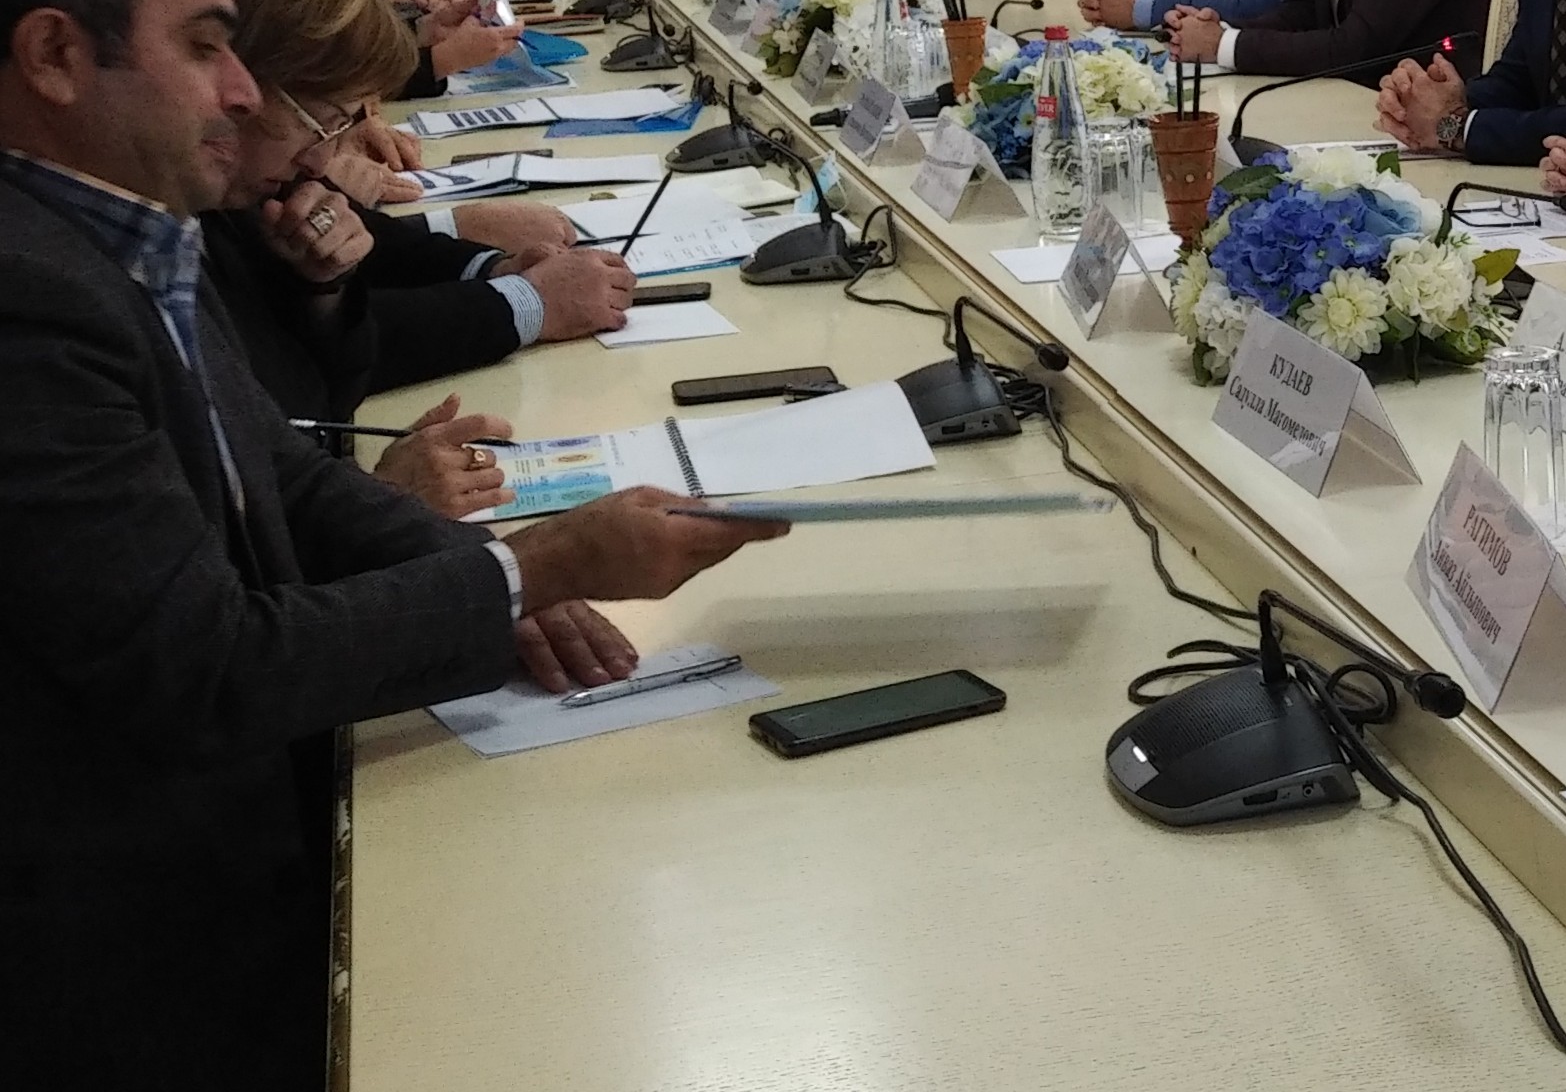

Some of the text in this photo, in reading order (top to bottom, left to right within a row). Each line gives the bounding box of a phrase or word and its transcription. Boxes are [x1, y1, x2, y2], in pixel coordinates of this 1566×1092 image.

[1269, 353, 1313, 396] КУДАЕВ
[1263, 397, 1327, 457] Магомедович
[1463, 504, 1513, 576] РАГИМОВ
